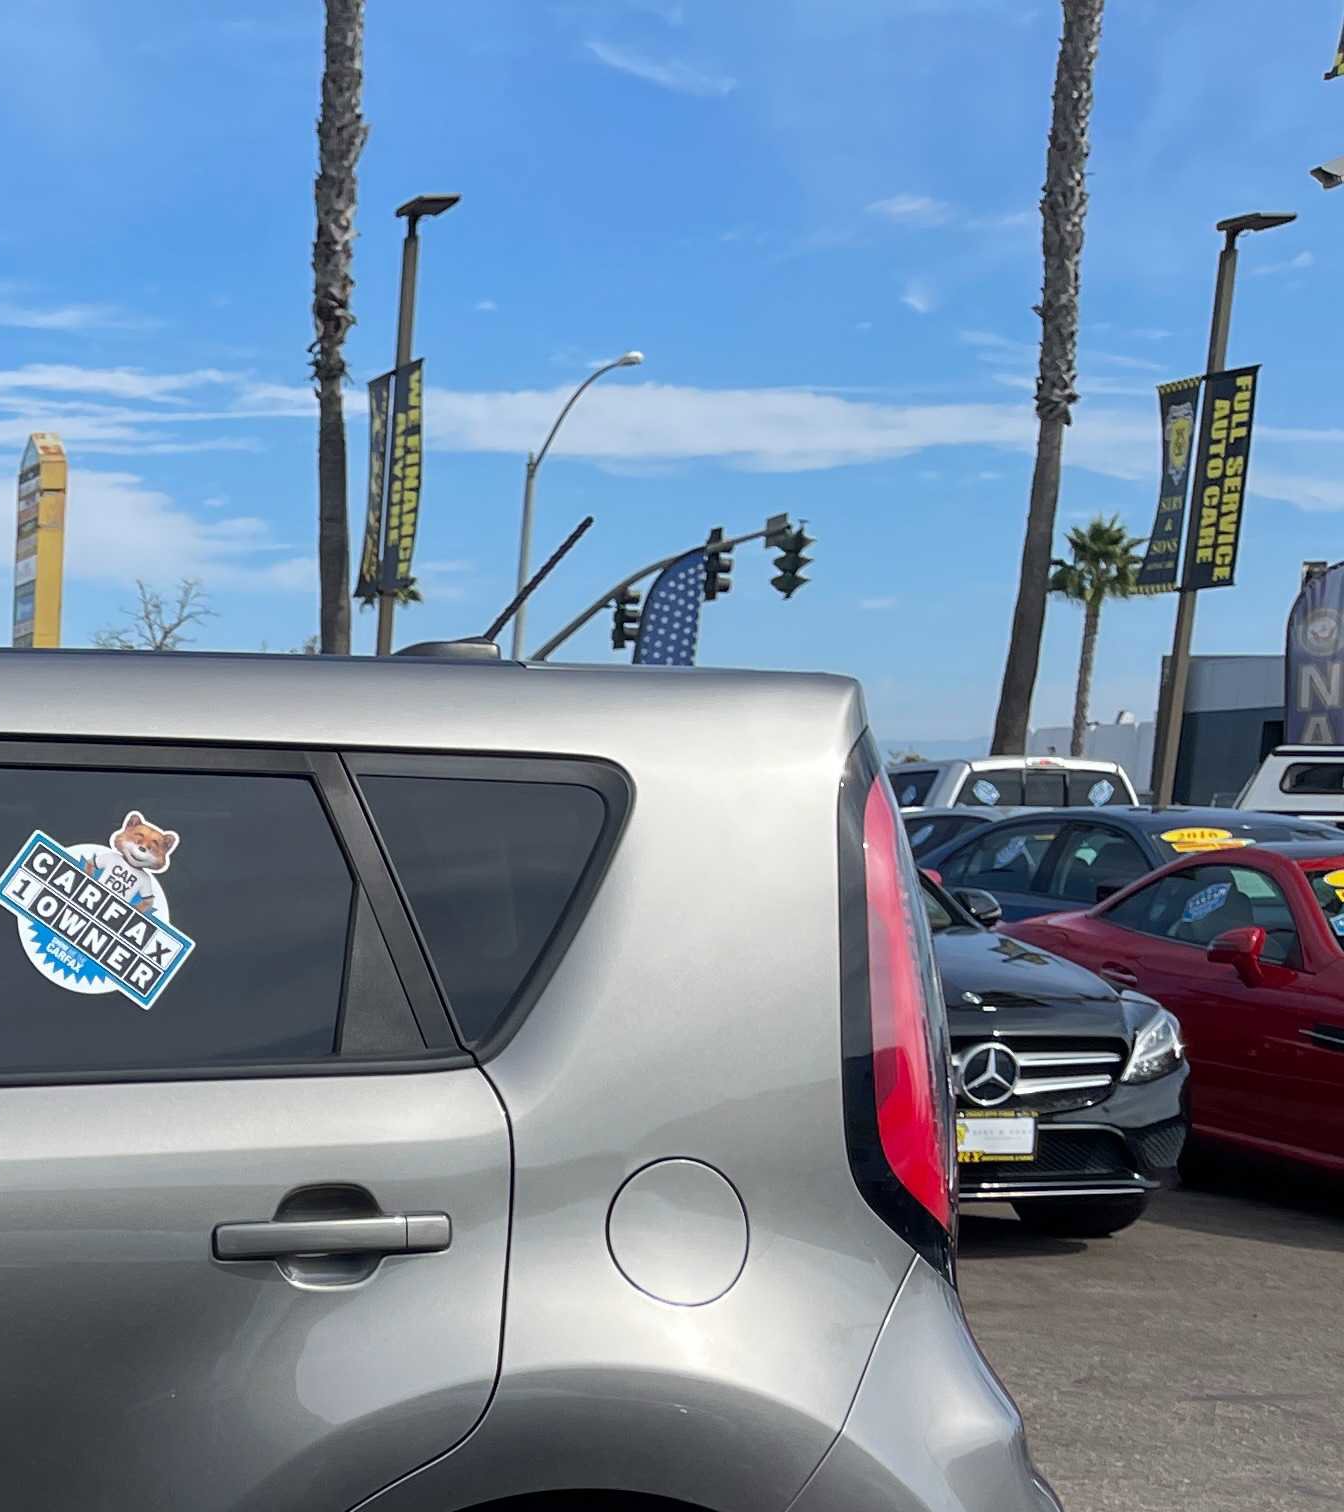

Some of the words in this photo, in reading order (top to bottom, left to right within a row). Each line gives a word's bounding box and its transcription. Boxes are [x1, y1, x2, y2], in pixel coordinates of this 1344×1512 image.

[1206, 398, 1231, 480] AUTO
[1229, 375, 1253, 444] FULL
[1196, 485, 1221, 564] CARE
[1212, 455, 1244, 582] SERVICE
[32, 851, 170, 968] CARFAX
[105, 877, 132, 898] FOX
[111, 865, 138, 885] CAR
[12, 877, 33, 901] 1
[36, 898, 154, 989] OWNER
[46, 942, 84, 974] CARFAX
